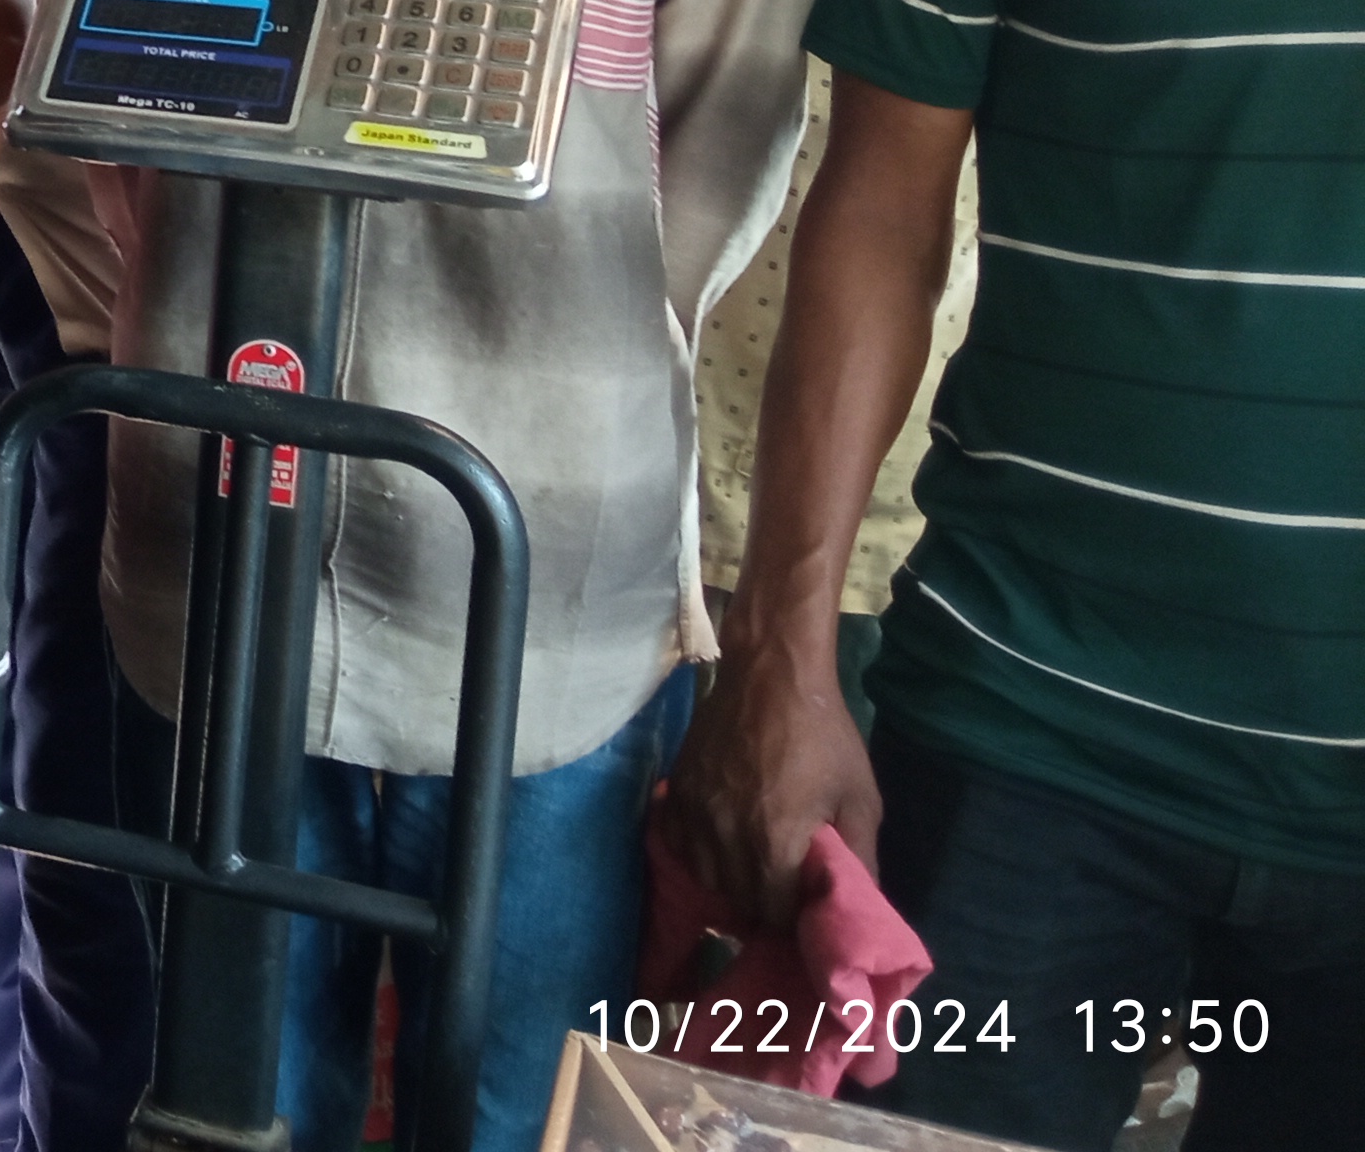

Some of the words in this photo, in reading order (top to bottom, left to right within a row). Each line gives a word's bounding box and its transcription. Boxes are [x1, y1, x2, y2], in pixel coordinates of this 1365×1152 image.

[409, 0, 424, 17] 5
[459, 6, 473, 22] 6
[356, 27, 366, 43] 1
[403, 31, 418, 48] 2
[451, 36, 467, 53] 3
[142, 45, 178, 58] TOTAL
[180, 49, 216, 62] PRICE
[346, 56, 362, 73] 0
[445, 67, 461, 84] C
[117, 95, 153, 108] Mega
[156, 98, 196, 113] TC-10
[361, 128, 403, 142] Japan
[407, 134, 473, 149] Standard
